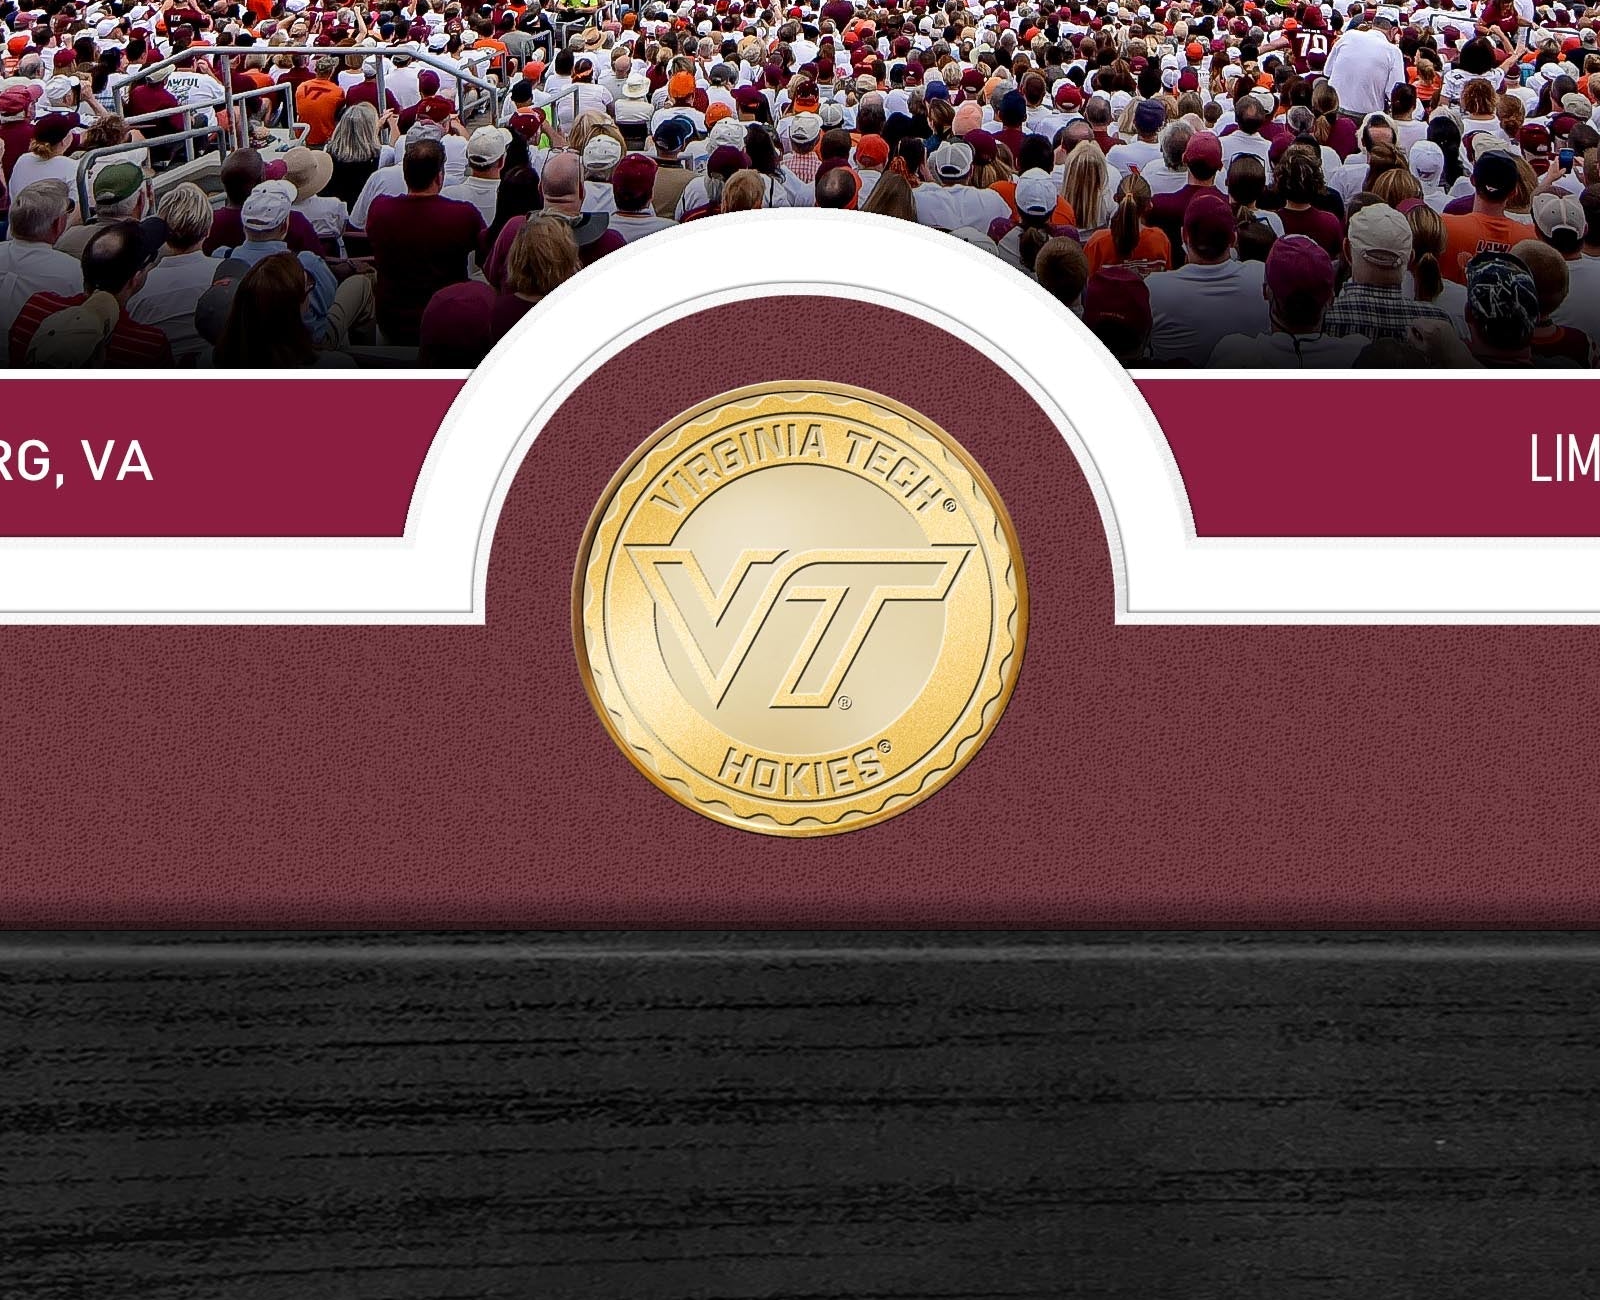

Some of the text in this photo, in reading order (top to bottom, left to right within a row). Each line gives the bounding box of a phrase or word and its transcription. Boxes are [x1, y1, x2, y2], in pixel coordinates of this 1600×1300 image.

[1296, 33, 1328, 57] 70
[80, 439, 154, 481] VA
[649, 422, 829, 517] VIRGINIA
[622, 543, 978, 711] VT
